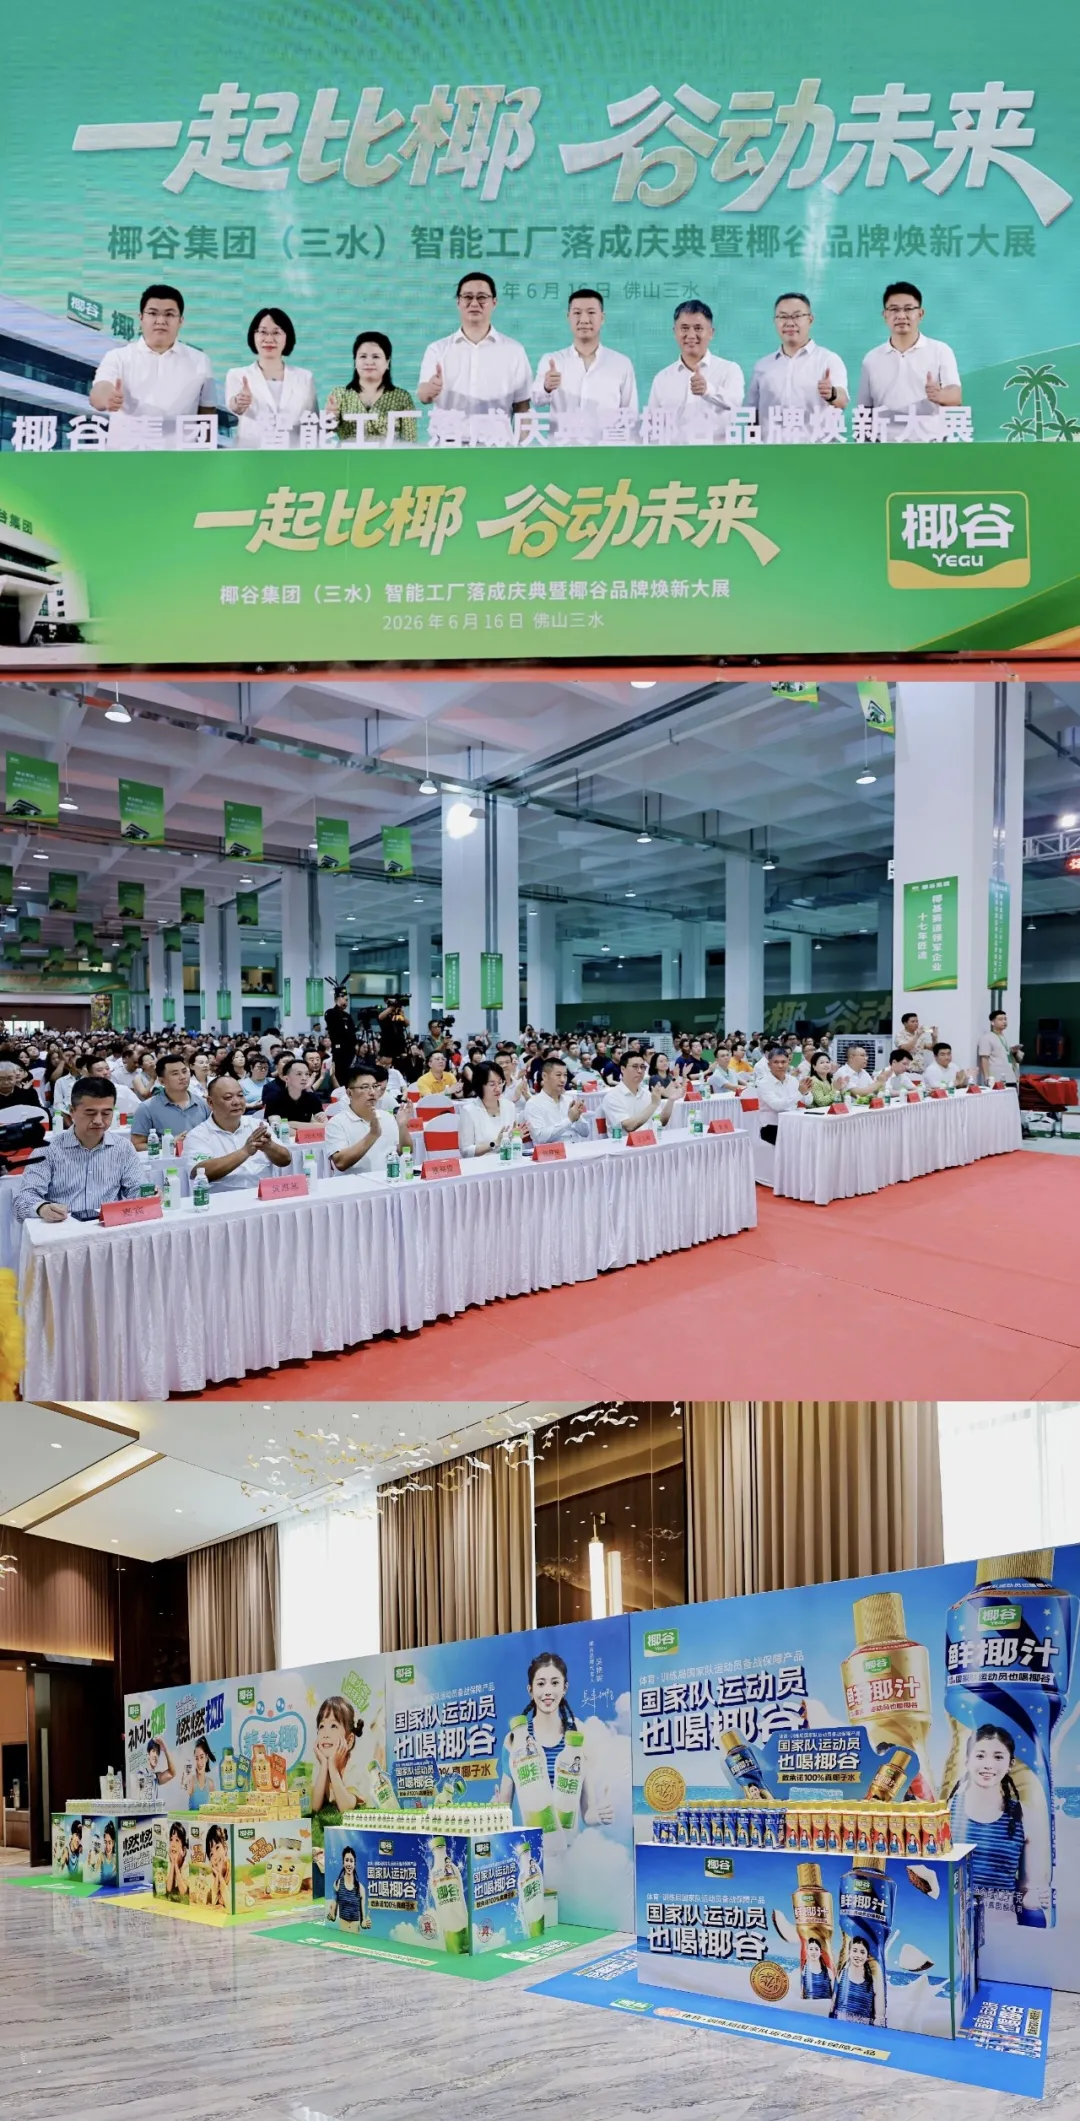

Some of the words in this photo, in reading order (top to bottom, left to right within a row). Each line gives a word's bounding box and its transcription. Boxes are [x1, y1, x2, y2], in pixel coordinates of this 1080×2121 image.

[72, 82, 542, 201] 一起比椰
[558, 78, 1074, 228] 谷动未来
[193, 484, 468, 556] 一起比椰
[476, 478, 781, 567] 谷动未来
[900, 503, 1015, 549] 椰谷
[932, 553, 984, 568] YEGU
[533, 611, 605, 629] 佛山三水
[982, 1608, 1017, 1621] 椰谷
[647, 1632, 675, 1647] 椰谷
[947, 1637, 1060, 1671] 鲜椰汁
[638, 1665, 808, 1717] 国家队运动员
[393, 1694, 497, 1734] 国家队运动员
[393, 1723, 497, 1762] 也喝椰谷
[777, 1738, 861, 1753] 国家队运动员
[777, 1752, 861, 1771] 也喝椰谷
[707, 1859, 731, 1870] 椰谷
[646, 1902, 769, 1930] 国家队运动员
[647, 1926, 769, 1962] 也喝椰谷
